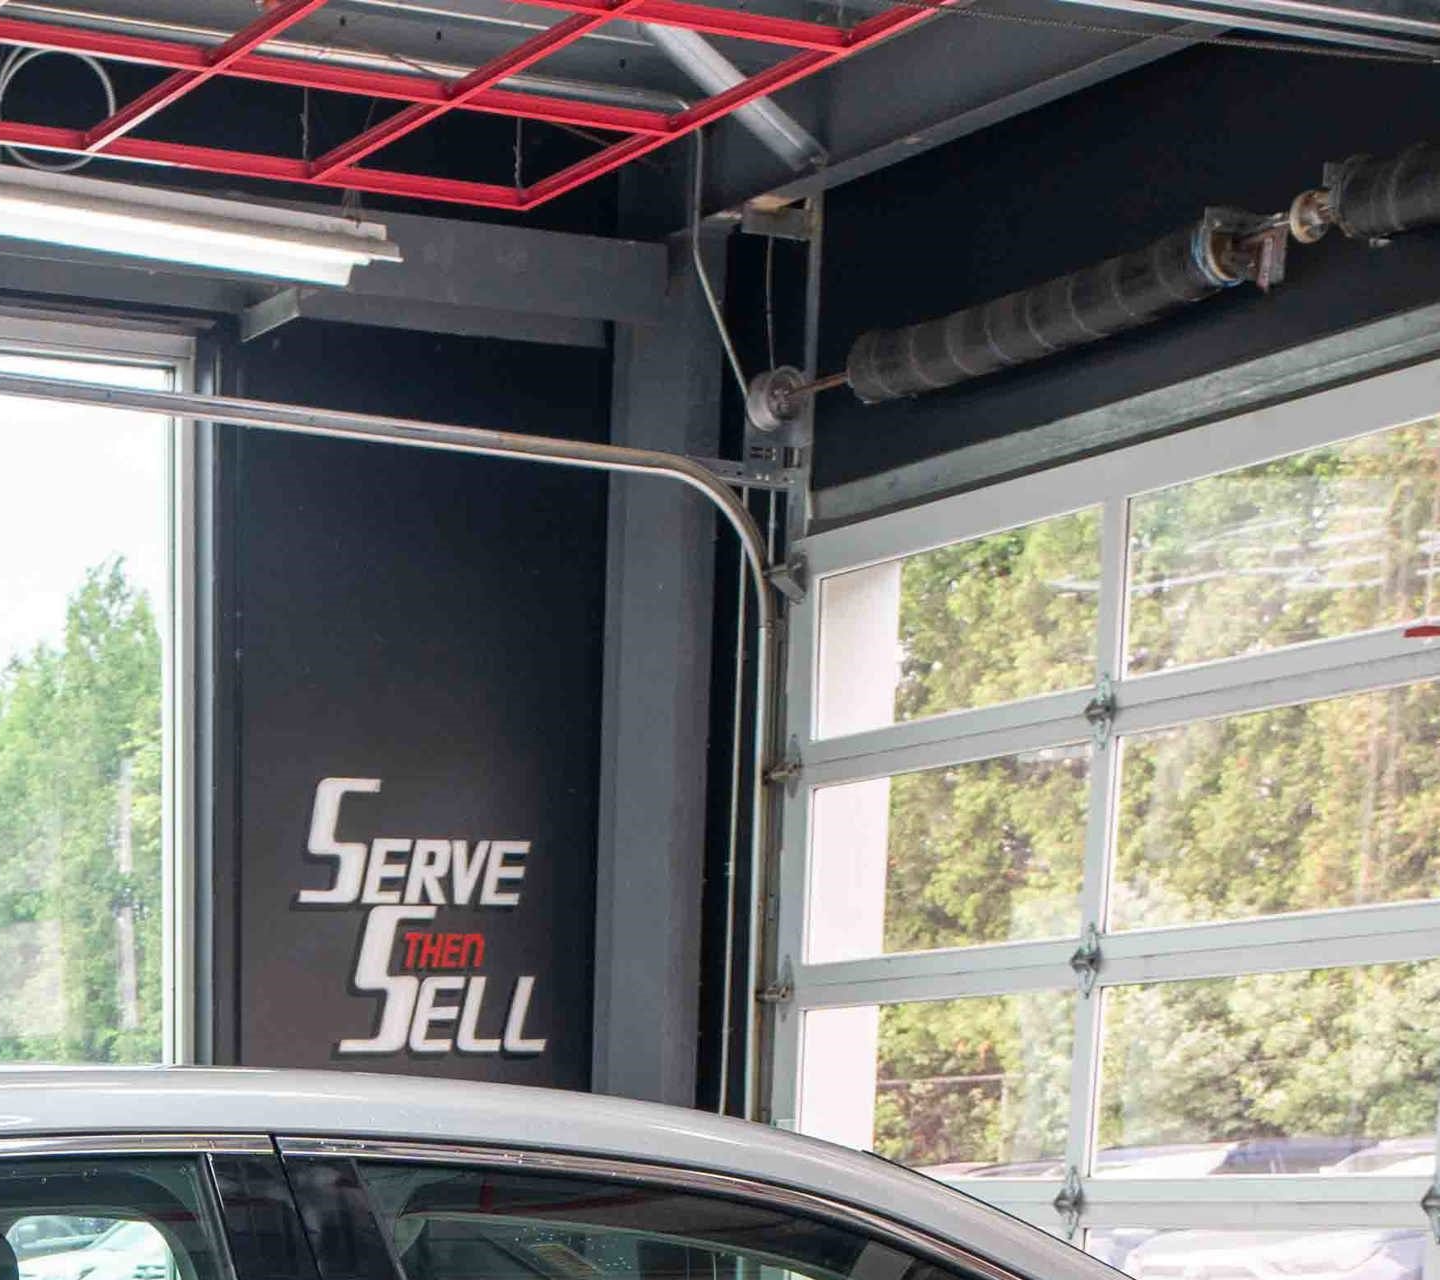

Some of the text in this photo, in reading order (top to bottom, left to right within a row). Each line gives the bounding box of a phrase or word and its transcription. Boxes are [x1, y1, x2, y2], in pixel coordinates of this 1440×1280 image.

[298, 777, 531, 905] SERVE
[338, 905, 548, 1053] SELL
[403, 932, 485, 970] THEN
